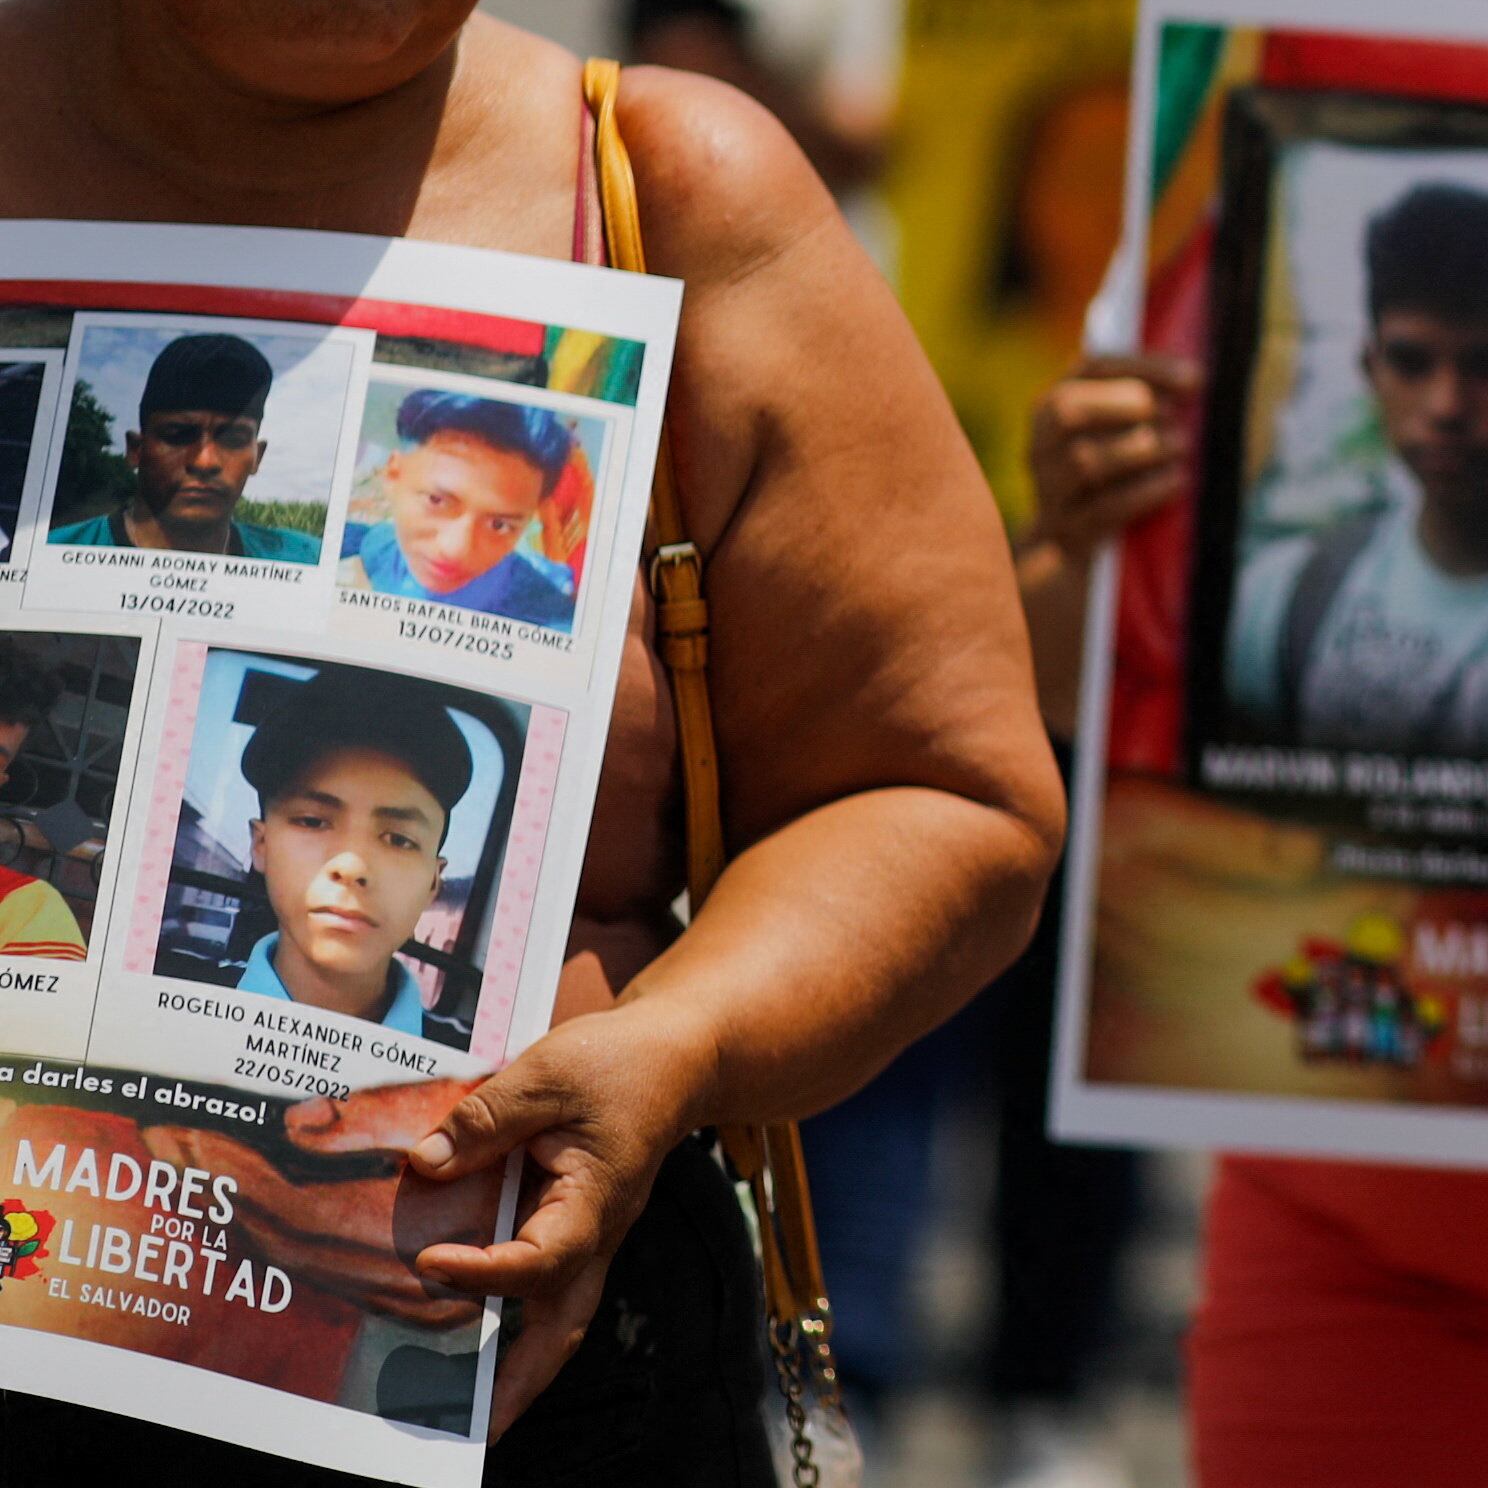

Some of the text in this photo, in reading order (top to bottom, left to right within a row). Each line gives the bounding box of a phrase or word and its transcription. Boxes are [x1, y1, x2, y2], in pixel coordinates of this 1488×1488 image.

[62, 550, 303, 583] GEOVANNI ADONAY MARTÍNEZ
[149, 573, 208, 592] GÓMEZ
[121, 593, 235, 619] 13/04/2022
[339, 590, 574, 652] SANTOS RAFAEL BRAN GÓMEZ
[398, 620, 514, 660] 13/07/2025
[158, 992, 438, 1077] ROGELIO ALEXANDER GÓMEZ
[245, 1033, 341, 1073] MARTÍNEZ
[22, 1061, 113, 1095] darles
[121, 1075, 148, 1100] el
[154, 1082, 267, 1125] abrazo!
[233, 1057, 350, 1103] 22/05/2022
[12, 1139, 238, 1225] MADRES
[150, 1213, 228, 1251] POR LA
[58, 1219, 293, 1314] LIBERTAD
[48, 1277, 192, 1327] EL SALVADOR
